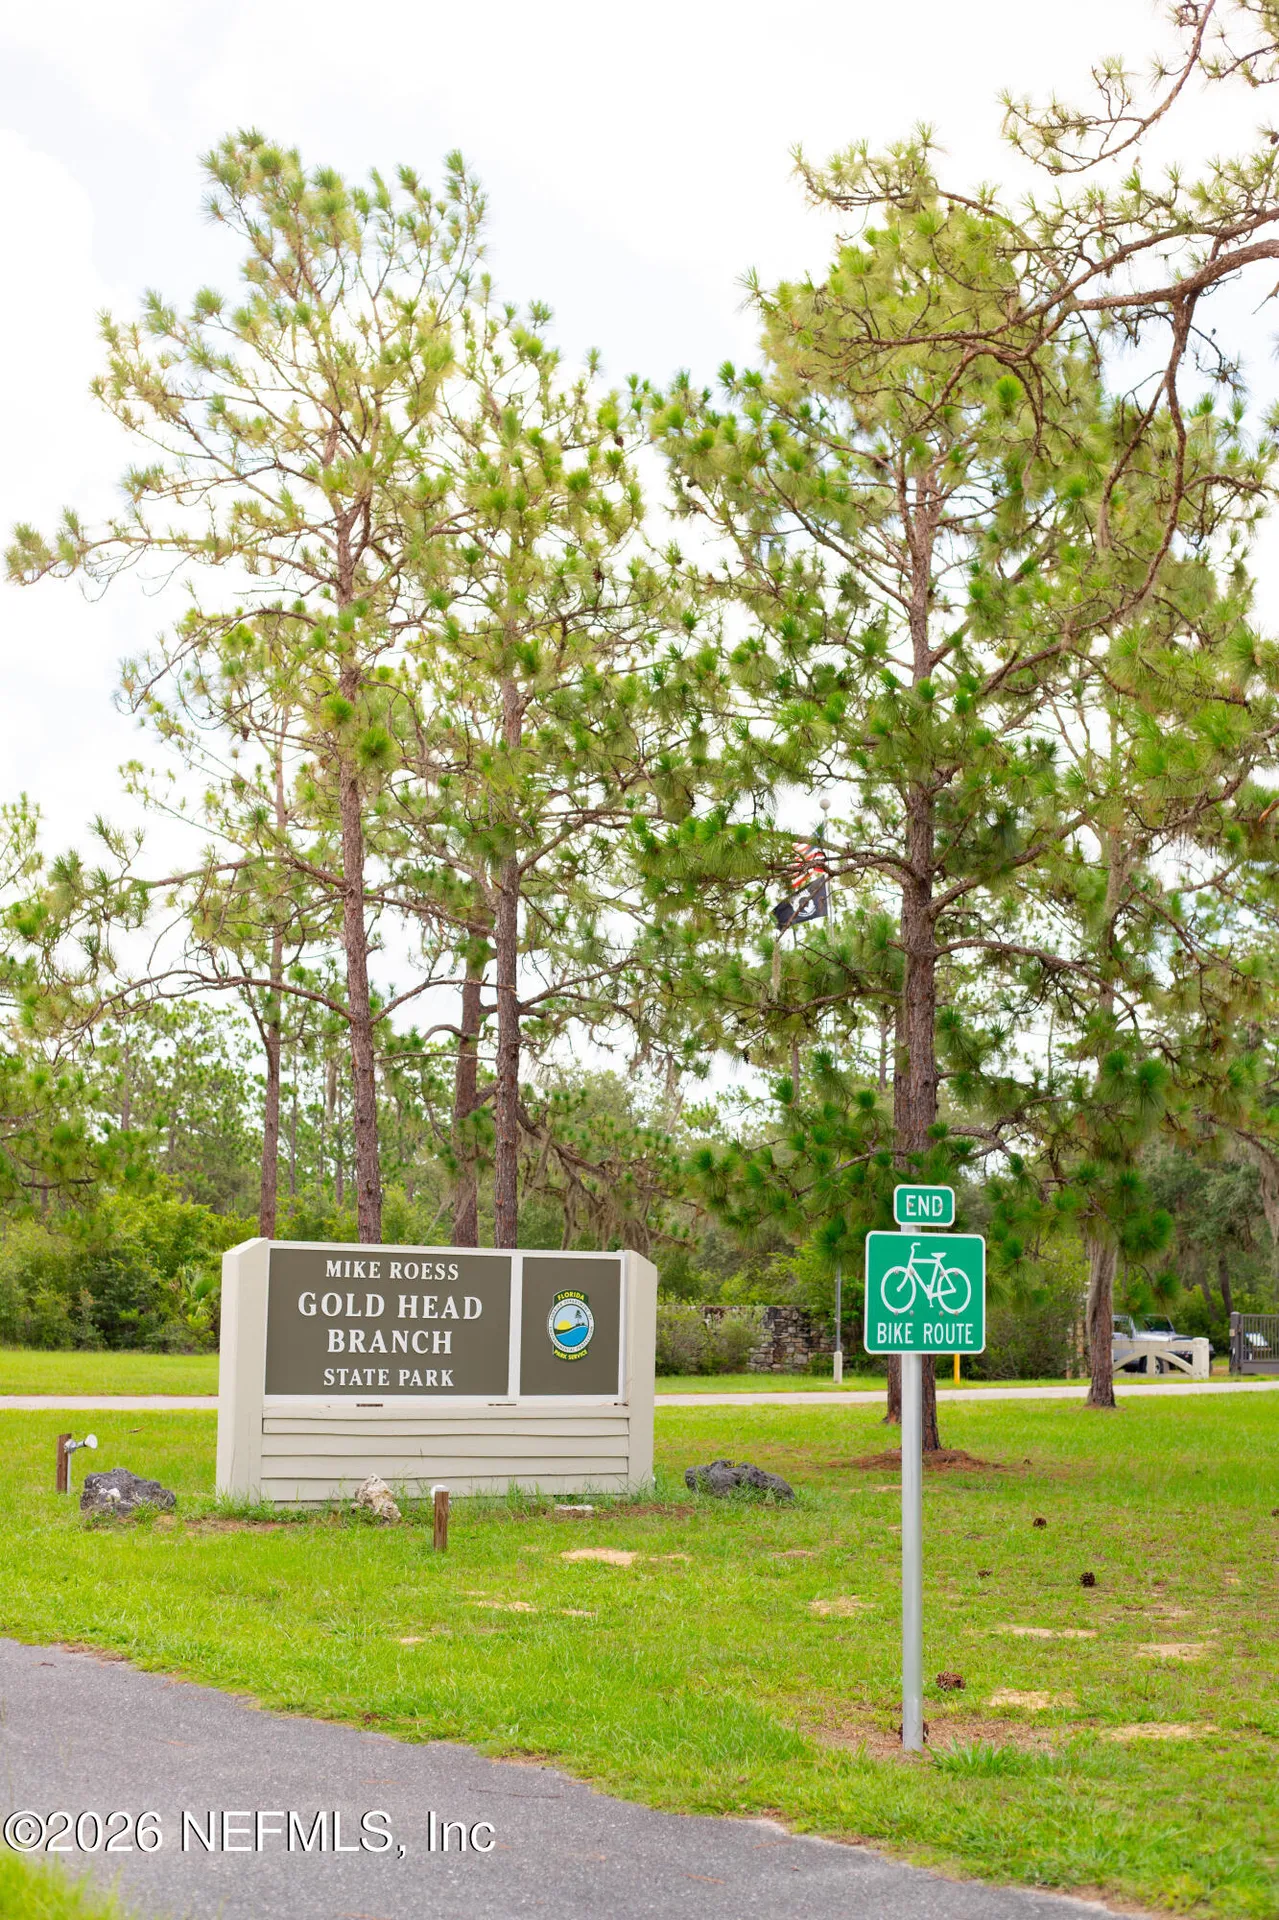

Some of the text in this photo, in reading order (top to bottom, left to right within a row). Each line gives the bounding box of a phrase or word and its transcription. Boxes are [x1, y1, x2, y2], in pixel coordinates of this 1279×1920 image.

[906, 1195, 943, 1217] END
[326, 1260, 458, 1280] MIKE ROESS
[299, 1292, 482, 1319] GOLD HEAD
[557, 1291, 584, 1300] FLORIDA
[328, 1329, 452, 1353] BRANCH
[877, 1322, 973, 1344] BIKE ROUTE
[553, 1349, 588, 1360] PARK SERVICE
[324, 1369, 453, 1386] STATE PARK
